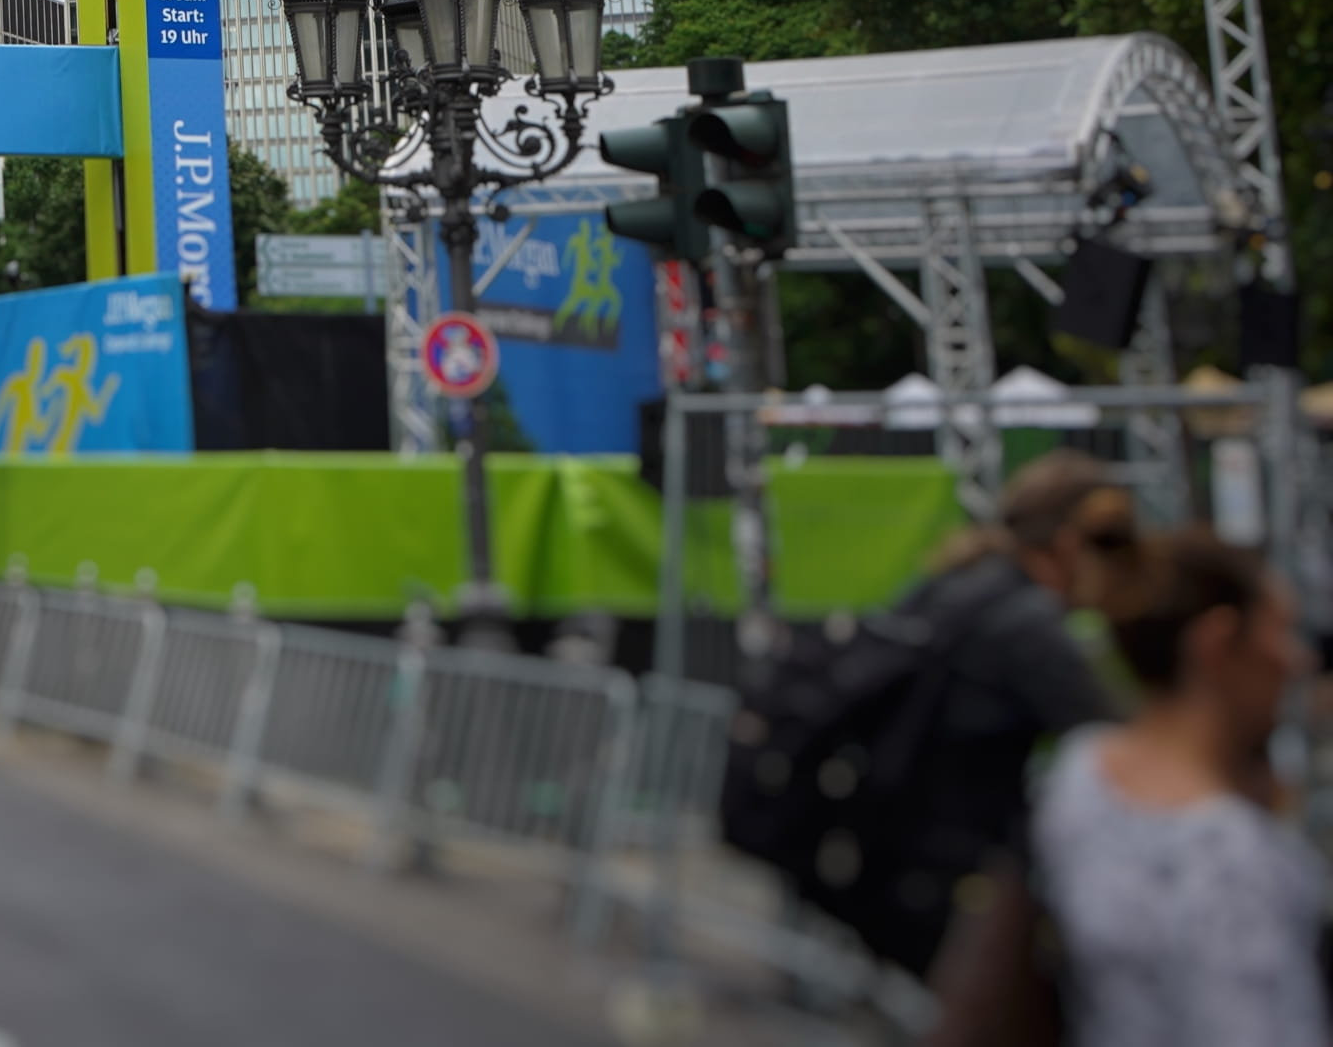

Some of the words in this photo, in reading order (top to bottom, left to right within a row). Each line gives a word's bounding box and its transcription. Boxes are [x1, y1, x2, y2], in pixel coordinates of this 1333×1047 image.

[162, 8, 204, 23] Start:
[161, 29, 178, 44] 19
[181, 29, 208, 45] Uhr
